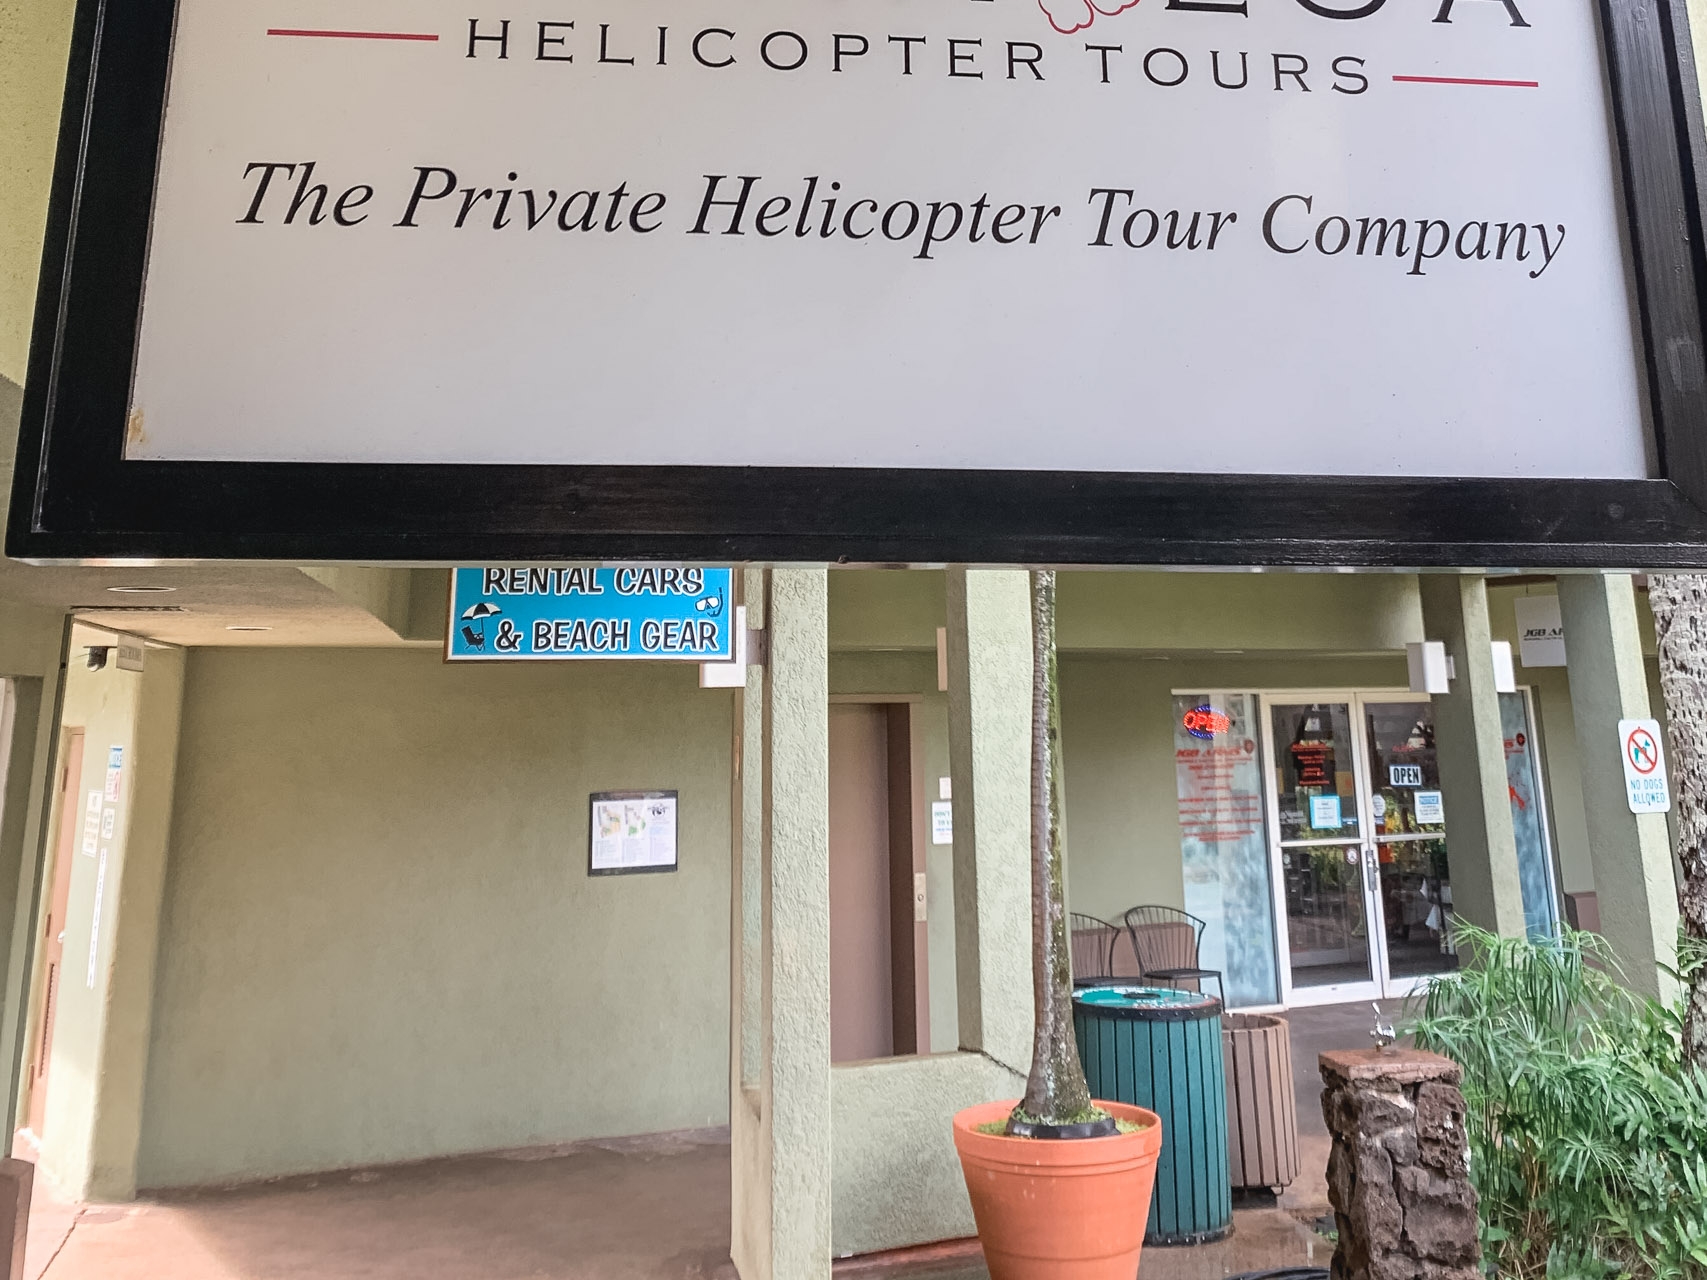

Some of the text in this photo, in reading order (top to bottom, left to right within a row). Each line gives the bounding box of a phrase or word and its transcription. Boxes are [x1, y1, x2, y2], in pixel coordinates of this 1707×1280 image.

[465, 18, 1370, 95] HELICOPTER TOURS
[235, 161, 1566, 279] The Private Helicopter Tour Company
[483, 567, 703, 595] RENTAL CARS
[495, 620, 718, 650] & BEACH GEAR
[1523, 628, 1546, 637] JGB
[1183, 710, 1231, 734] OPEN
[1393, 767, 1420, 784] OPEN
[1630, 778, 1664, 790] NO DOGS
[1632, 792, 1666, 804] ALLOWED
